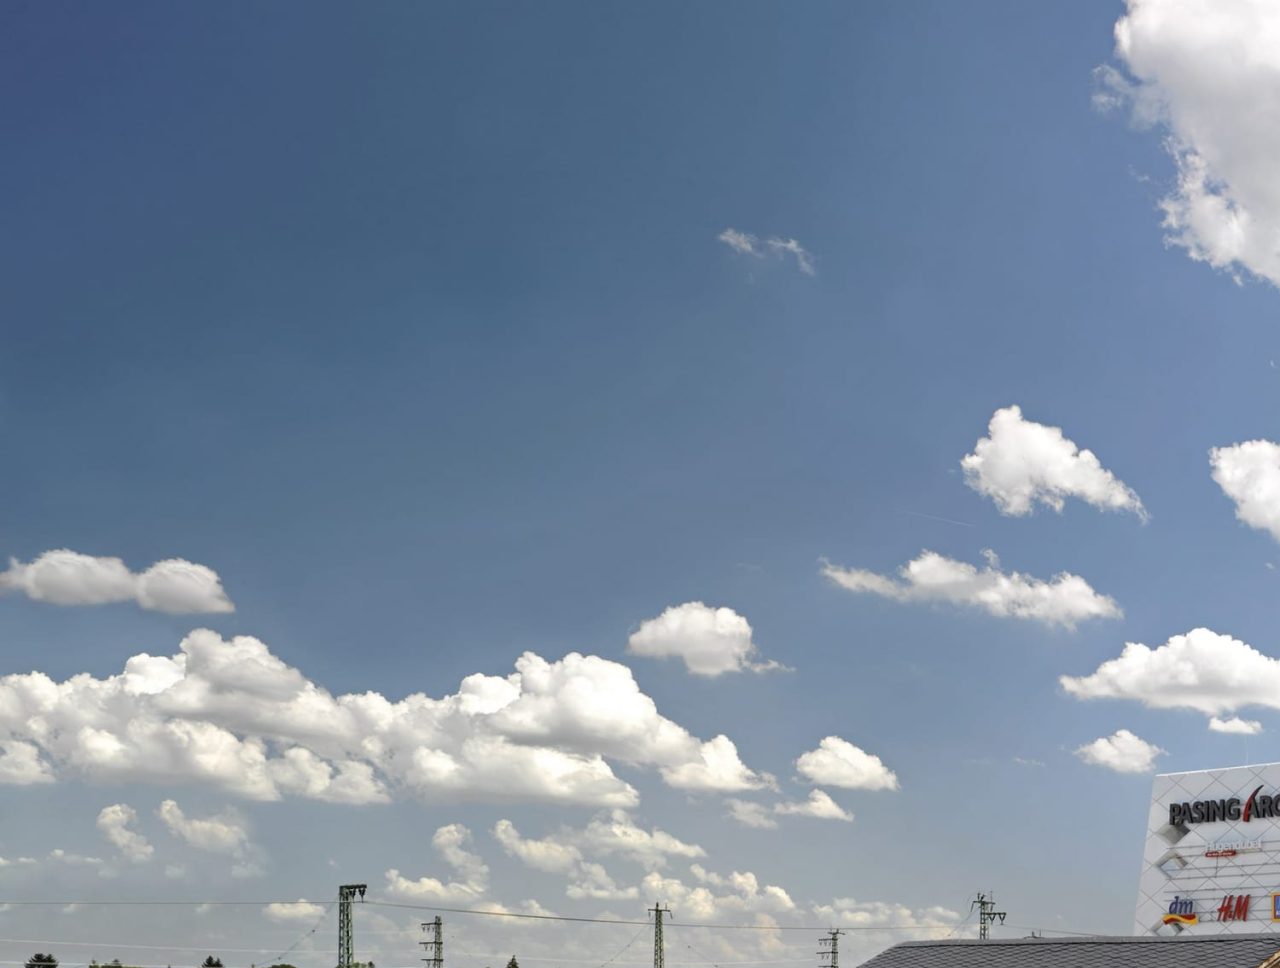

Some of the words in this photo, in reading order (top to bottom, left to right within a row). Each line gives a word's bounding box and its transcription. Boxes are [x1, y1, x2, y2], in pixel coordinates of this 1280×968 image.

[1169, 800, 1241, 825] PASING
[1168, 896, 1193, 915] dm
[1217, 894, 1251, 922] H&M
